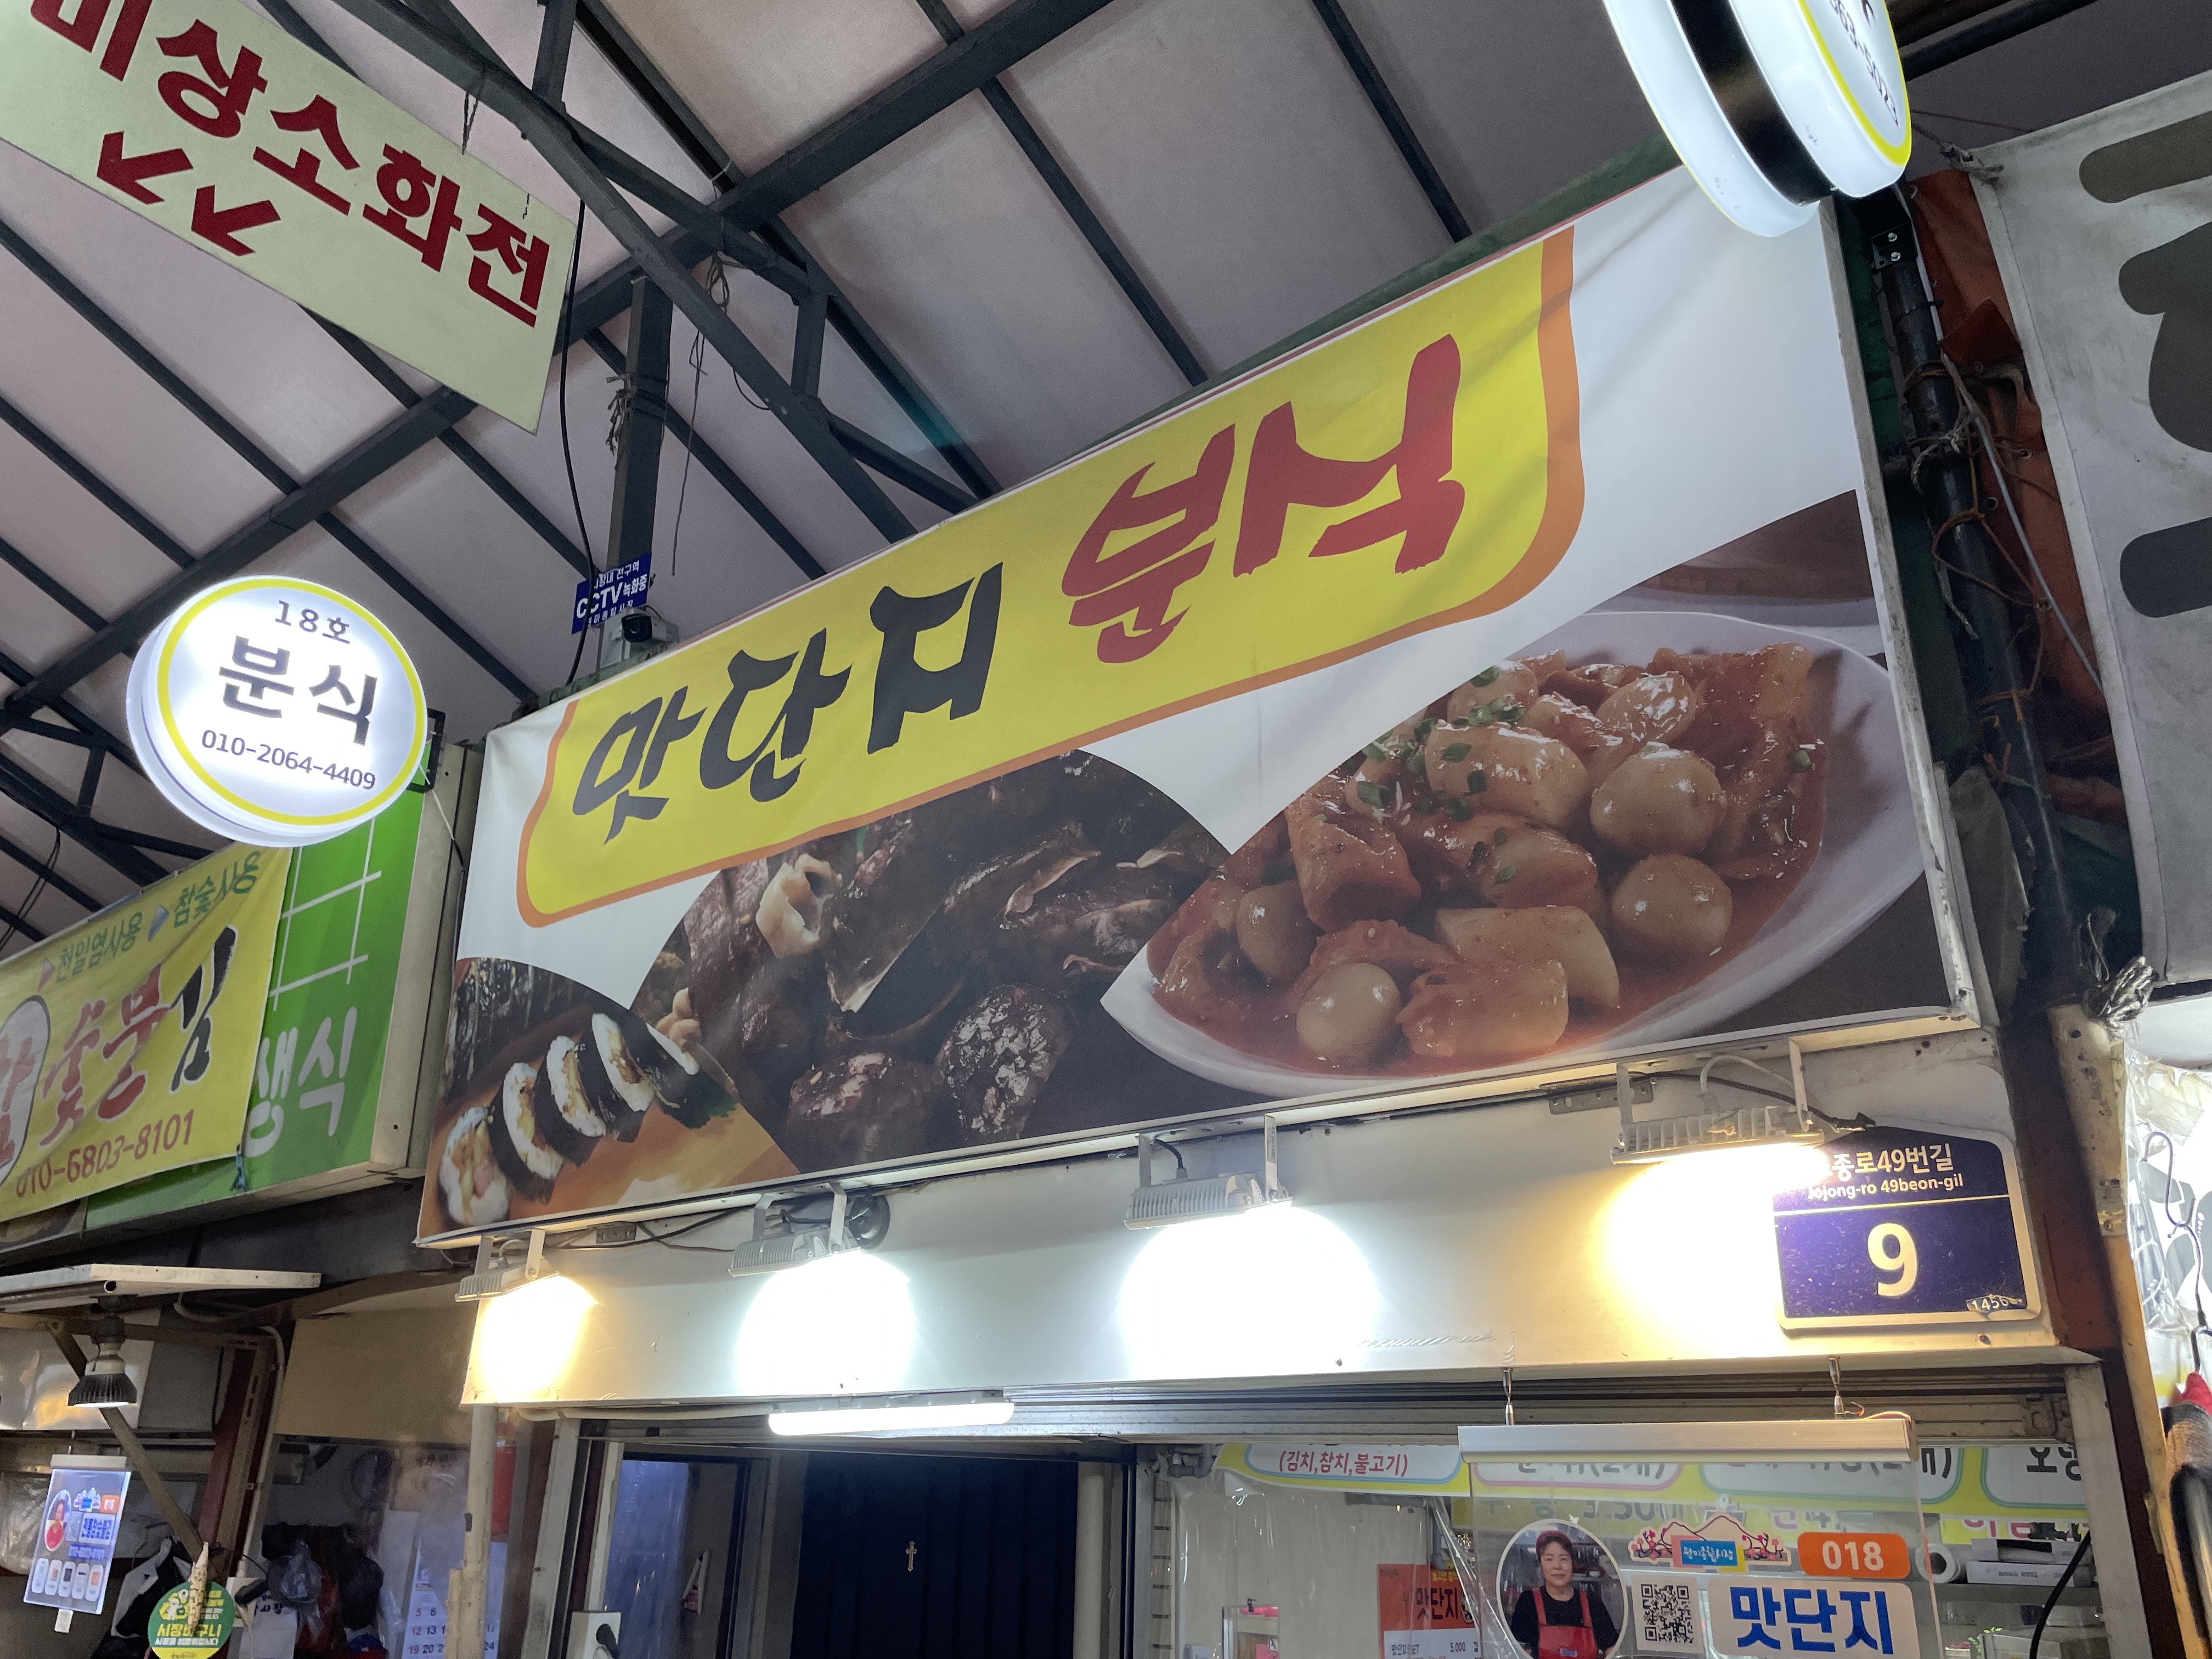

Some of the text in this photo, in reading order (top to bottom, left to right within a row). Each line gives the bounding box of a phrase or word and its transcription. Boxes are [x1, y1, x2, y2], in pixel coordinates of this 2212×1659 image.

[572, 333, 1466, 844] 맛단지 분식
[616, 560, 640, 580] 전구역
[577, 574, 647, 618] CCTV 녹화중
[275, 600, 350, 645] 18호
[218, 635, 377, 747] 분식
[201, 729, 376, 789] 010-2064-4409
[15, 1109, 195, 1199] 010-6803-8101
[1826, 1143, 1954, 1182] 종로49번길
[1880, 1173, 1964, 1192] 49beon-gil
[1867, 1223, 1918, 1297] 9
[1279, 1451, 1408, 1477] (김치,참치,불고기)
[1821, 1539, 1885, 1572] 018
[1416, 1588, 1458, 1620] 맛단지
[1730, 1586, 1894, 1655] 맛단지
[422, 1645, 434, 1655] 20
[426, 1626, 437, 1635] 13
